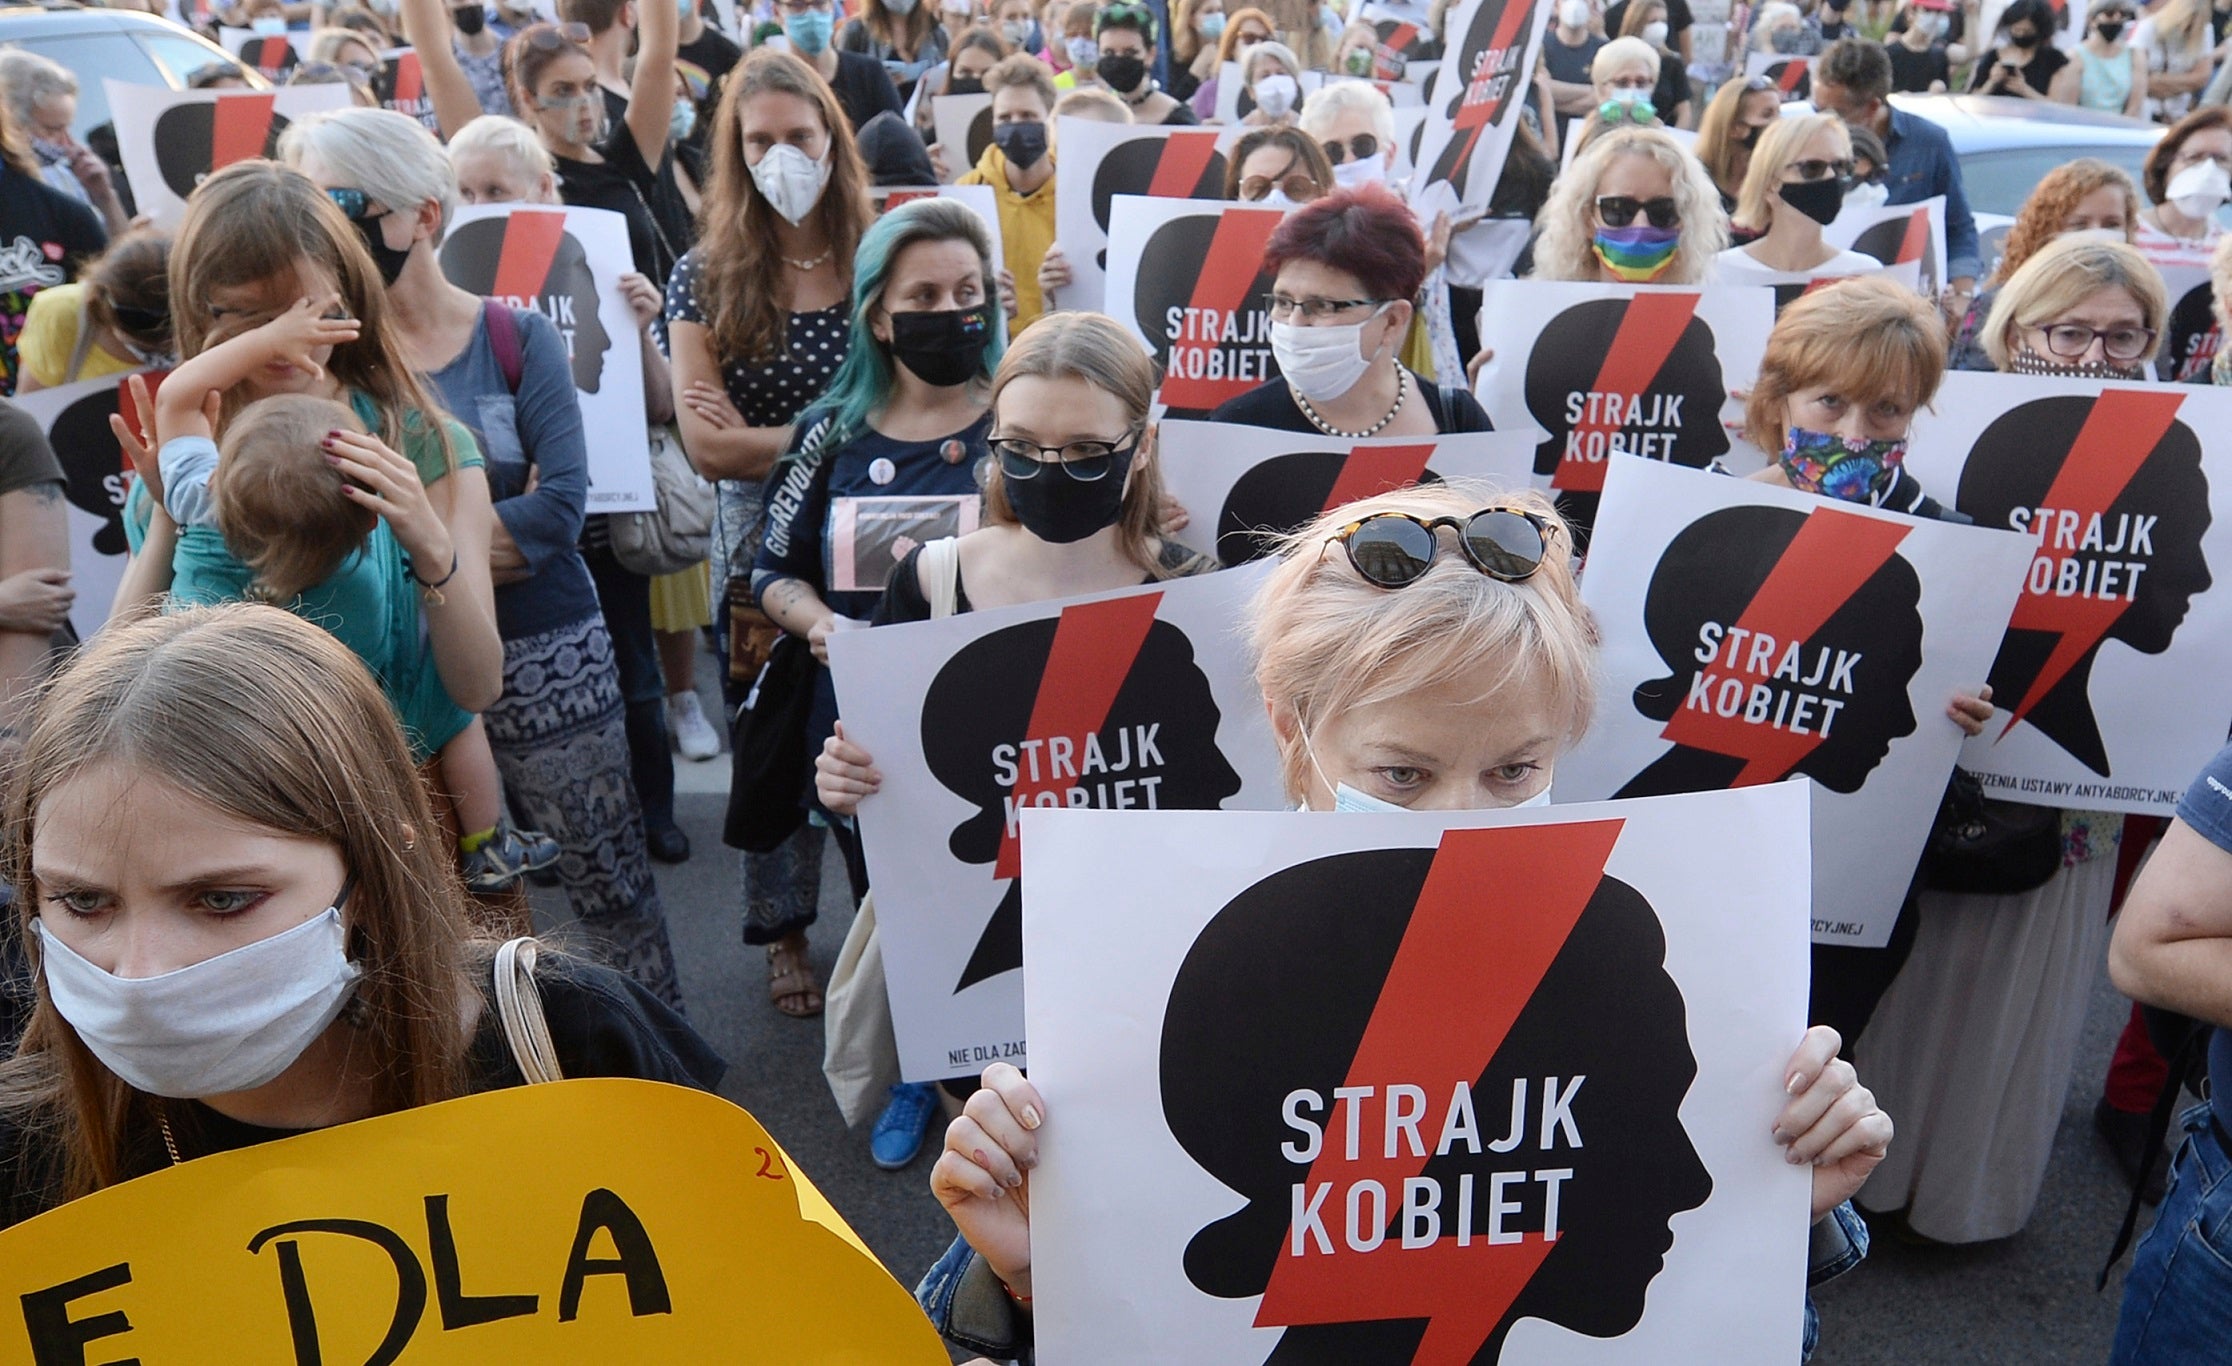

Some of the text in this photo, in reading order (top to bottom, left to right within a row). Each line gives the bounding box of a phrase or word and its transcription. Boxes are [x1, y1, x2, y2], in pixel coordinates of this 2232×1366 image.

[1166, 306, 1273, 343] STRAJK
[1168, 346, 1271, 381] KOBIET
[1565, 391, 1684, 427] STRAJK
[2009, 507, 2158, 555] STRAJK
[2021, 556, 2147, 602] OBIET
[1694, 621, 1862, 694] STRAJK
[1686, 670, 1844, 739] KOBIET
[992, 723, 1165, 786] STRAJK
[2021, 779, 2073, 796] USTAWY
[948, 1048, 971, 1066] NIE
[974, 1044, 1000, 1062] DLA
[1281, 1075, 1587, 1164] STRAJK
[754, 1147, 783, 1180] 2
[1291, 1168, 1573, 1257] KOBIET
[246, 1188, 672, 1366] DLA
